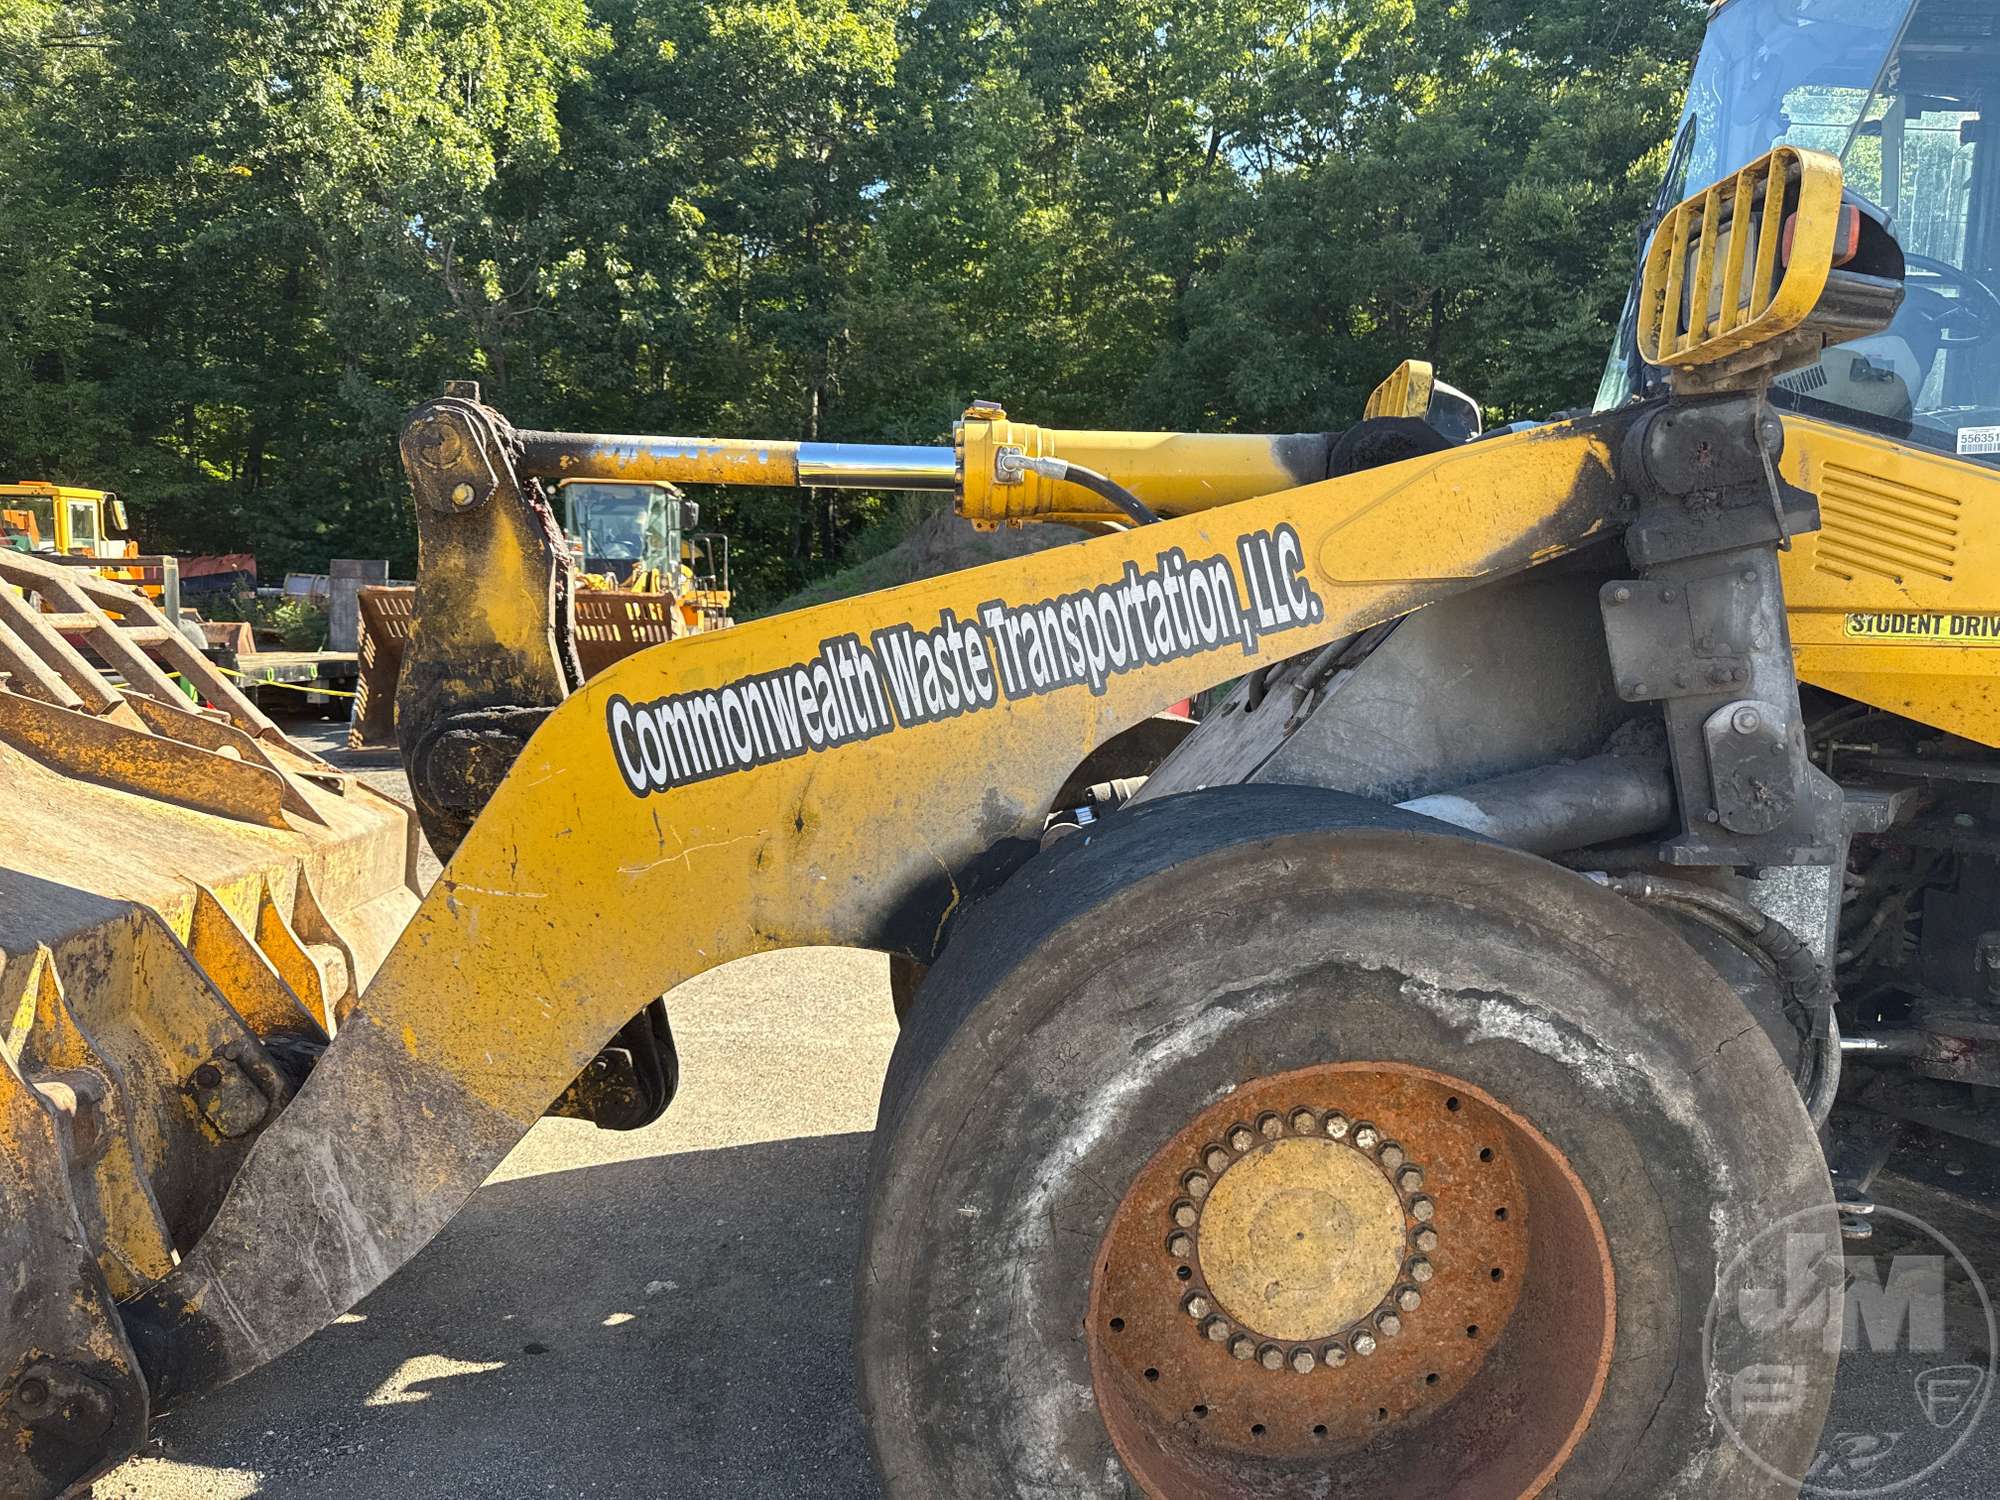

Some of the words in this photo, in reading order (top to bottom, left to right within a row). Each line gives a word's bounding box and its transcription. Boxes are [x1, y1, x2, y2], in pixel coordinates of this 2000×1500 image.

[610, 638, 891, 793] Commonwealth
[876, 613, 994, 722] Waste
[982, 553, 1253, 689] Transportation,
[1242, 529, 1320, 628] LLC.
[1851, 613, 1944, 634] STUDENT
